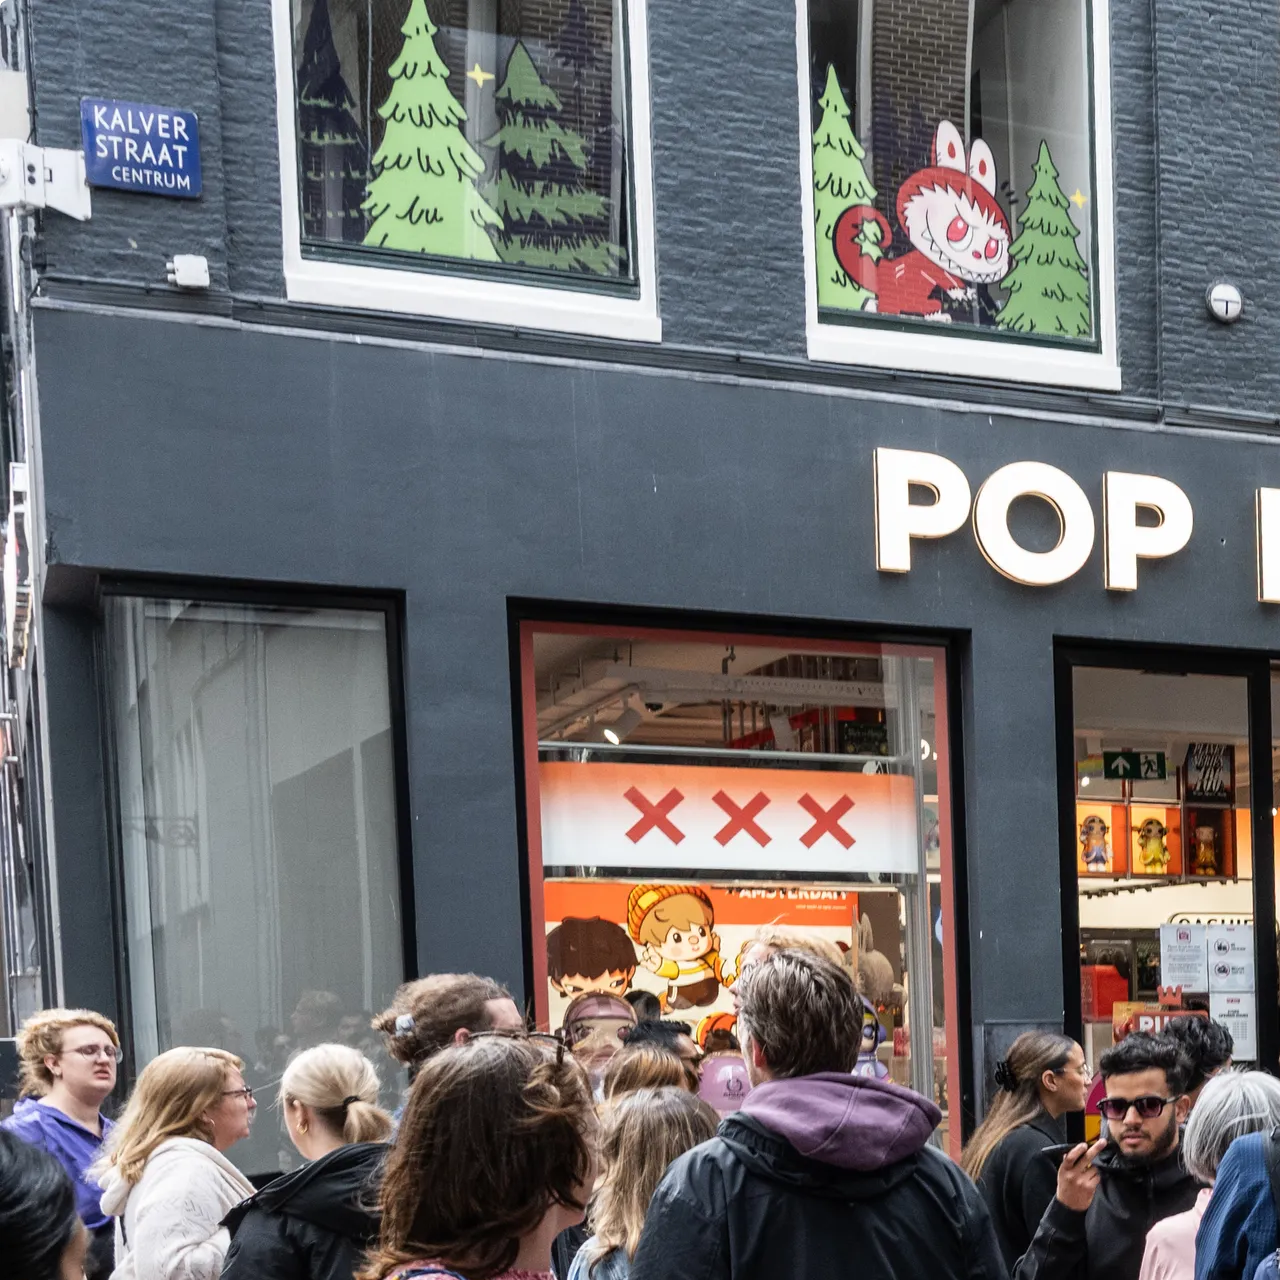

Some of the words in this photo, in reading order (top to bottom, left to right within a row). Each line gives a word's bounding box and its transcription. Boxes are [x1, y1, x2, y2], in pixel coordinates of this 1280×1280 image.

[94, 105, 190, 142] KALVER
[96, 134, 188, 170] STRAAT
[112, 165, 191, 191] CENTRUM
[873, 446, 1194, 592] POP
